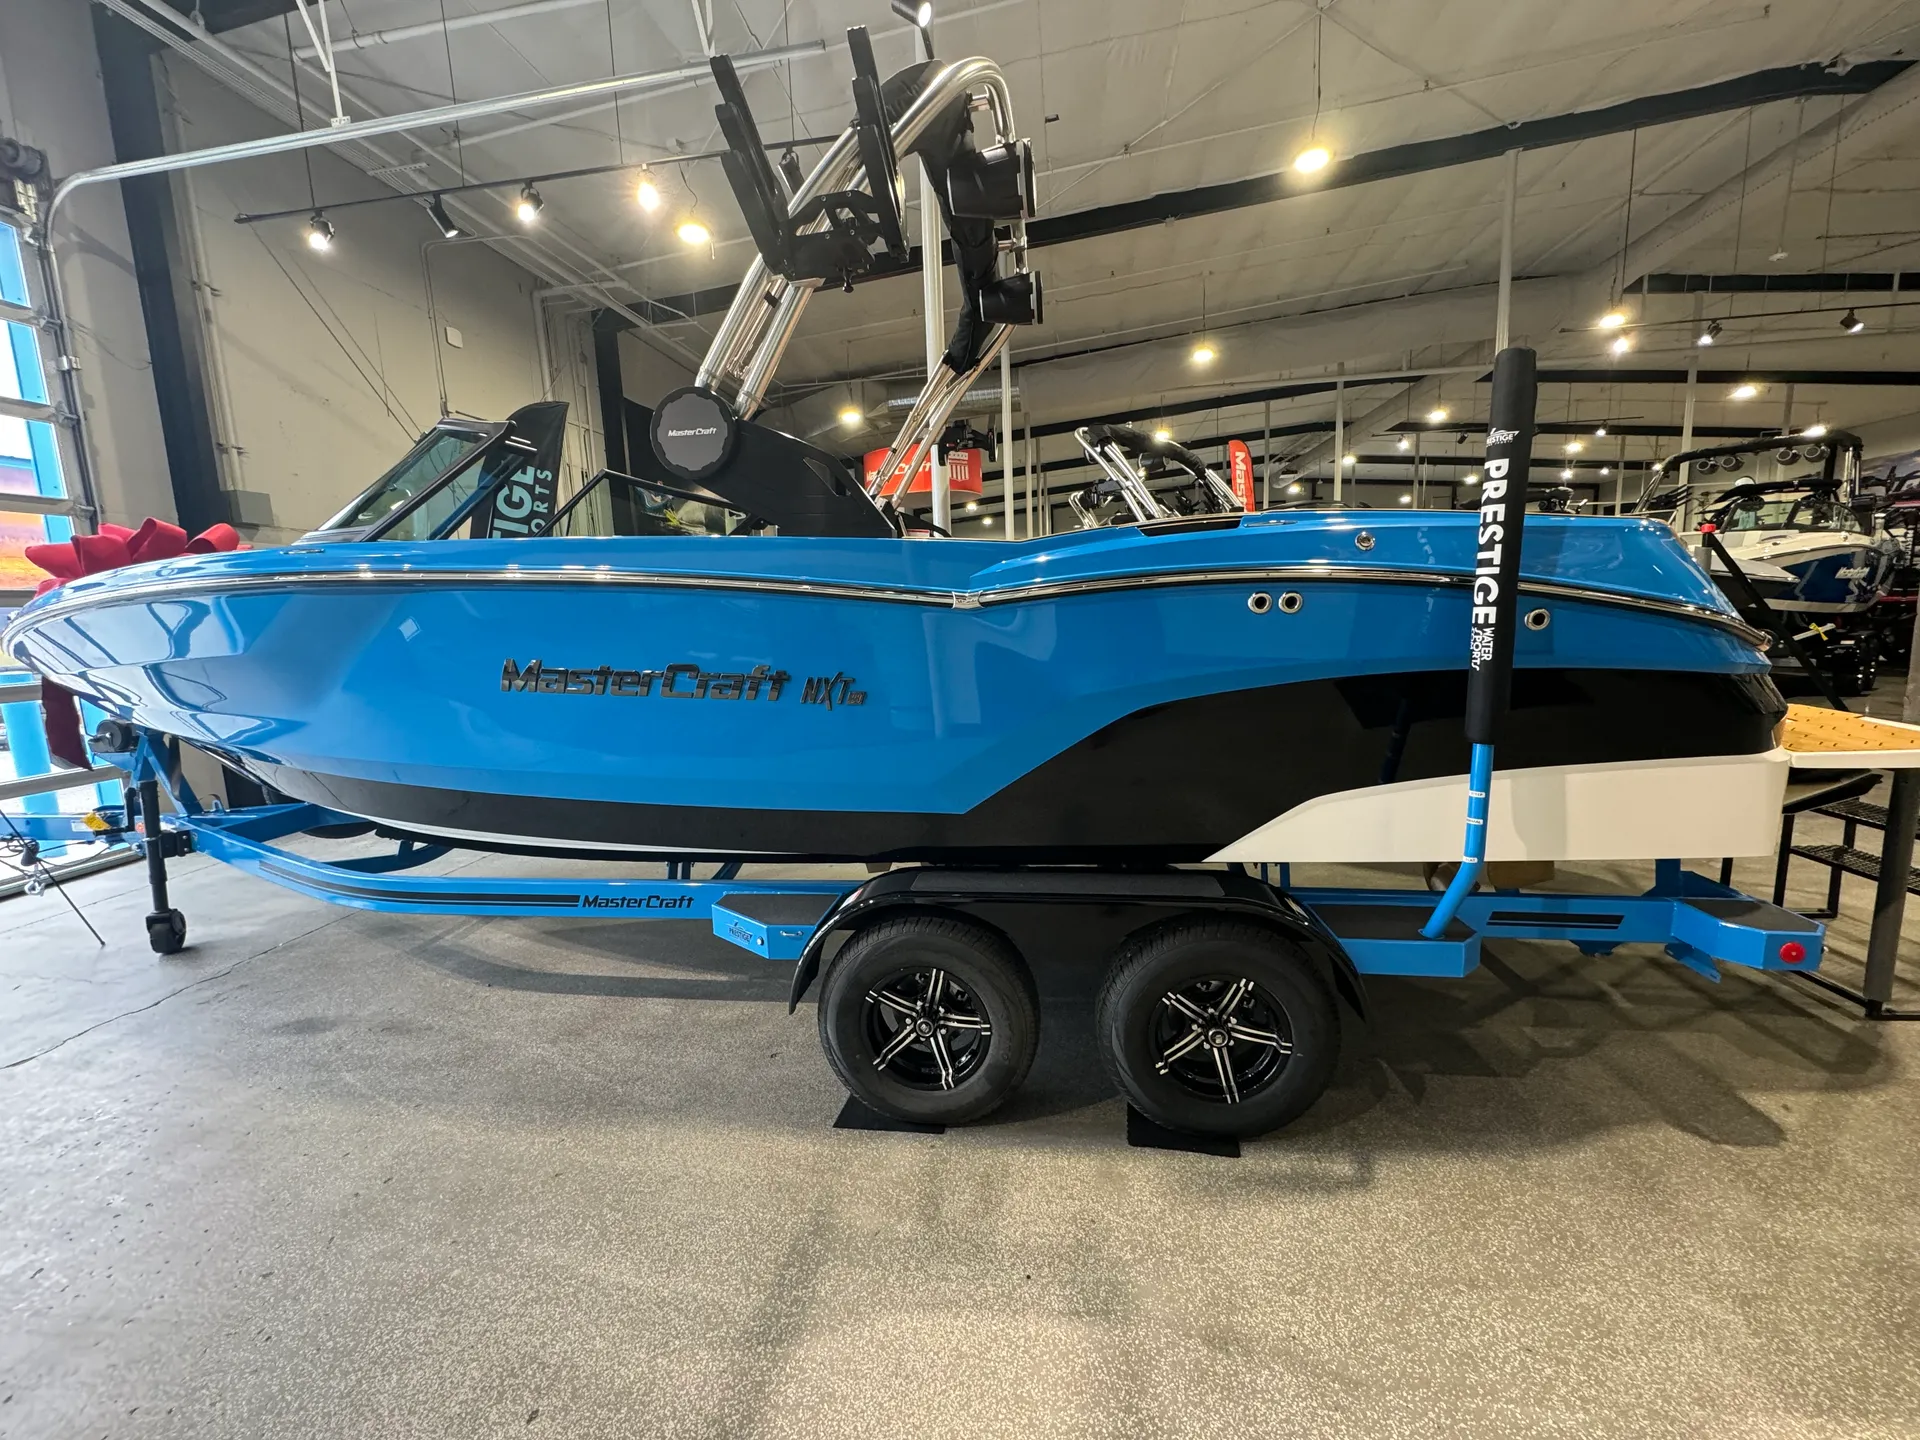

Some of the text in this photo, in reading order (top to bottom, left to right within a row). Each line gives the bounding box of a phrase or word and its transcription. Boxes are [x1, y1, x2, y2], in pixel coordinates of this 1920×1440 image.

[667, 427, 717, 437] MasterCraft
[1471, 458, 1510, 625] PRESTIGE
[1471, 627, 1483, 671] SPORTS
[1480, 627, 1496, 661] WATER
[501, 658, 792, 701] MasterCraft
[582, 894, 695, 909] MasterCraft
